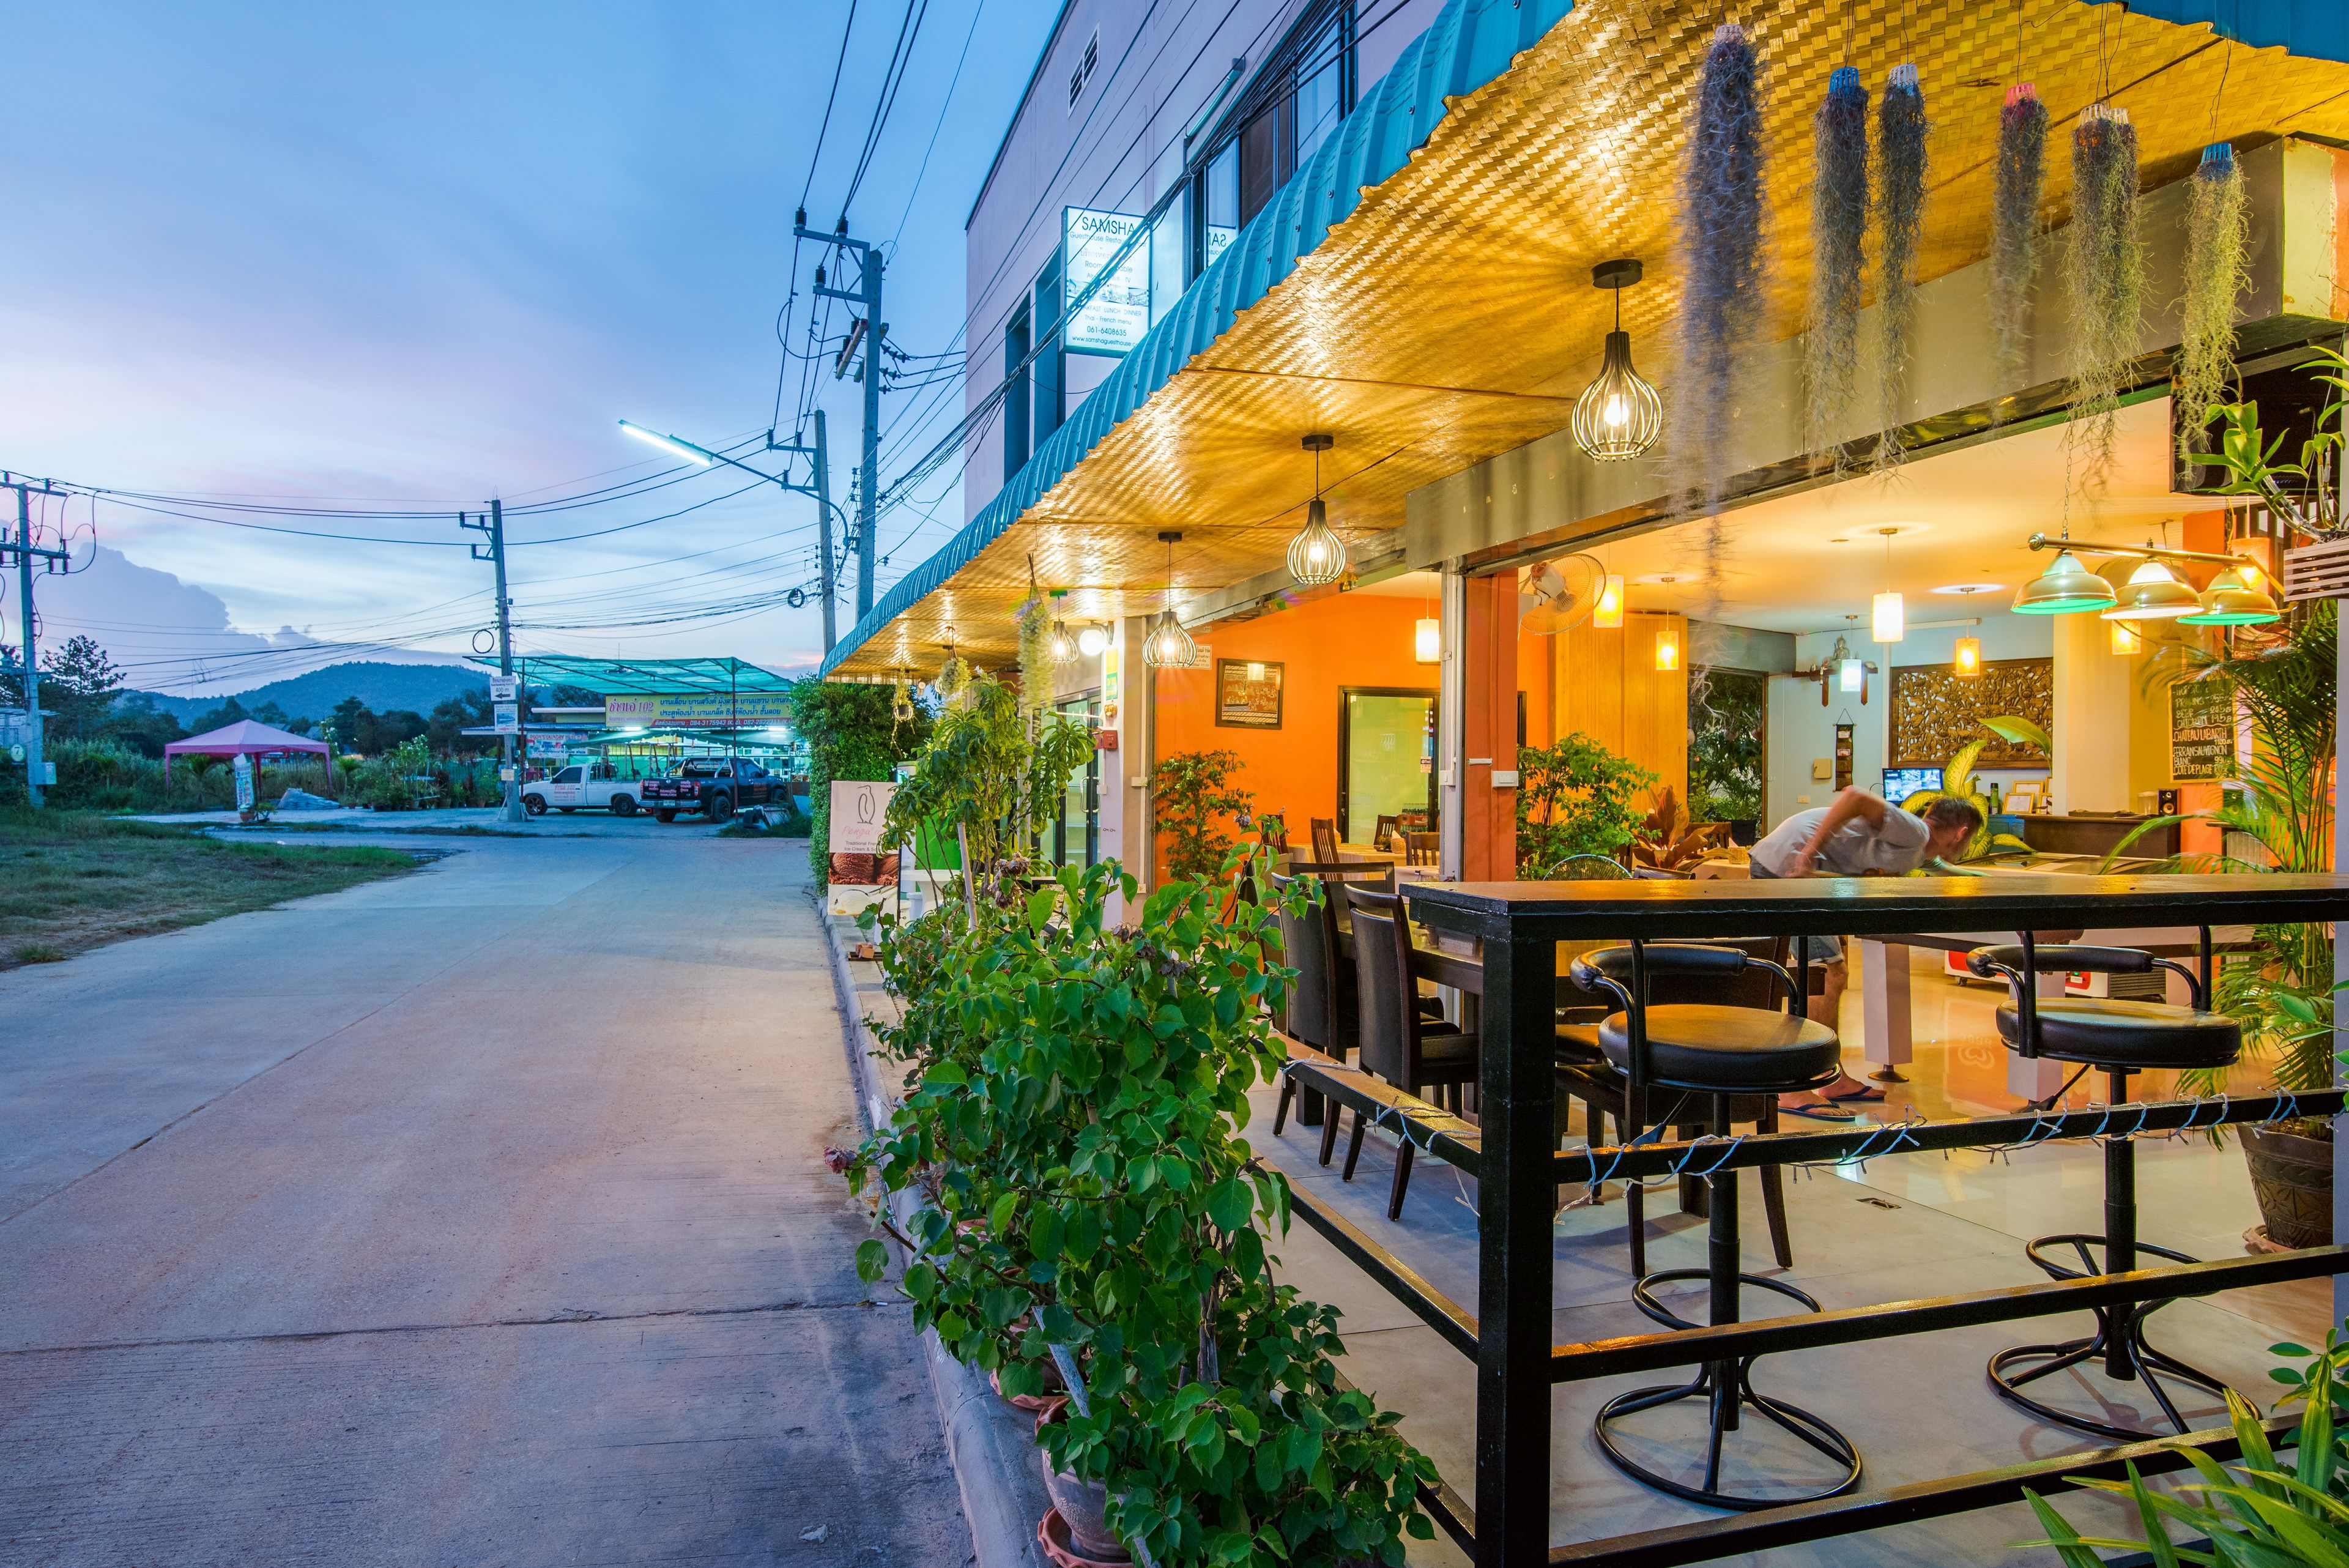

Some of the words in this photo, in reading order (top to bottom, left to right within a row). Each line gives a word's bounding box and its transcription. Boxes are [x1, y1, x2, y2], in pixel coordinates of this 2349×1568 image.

[1082, 217, 1135, 236] SAMSHA
[1069, 231, 1104, 242] Guesthouse
[1086, 325, 1127, 336] 061-6408635
[639, 701, 654, 712] 102
[2176, 708, 2194, 719] BEEF
[2174, 729, 2200, 741] CHATEAU
[2200, 727, 2227, 740] LABARTH
[2194, 745, 2227, 756] SAUVIGNON
[2173, 757, 2191, 766] BLANC
[2195, 764, 2213, 775] PLAGE
